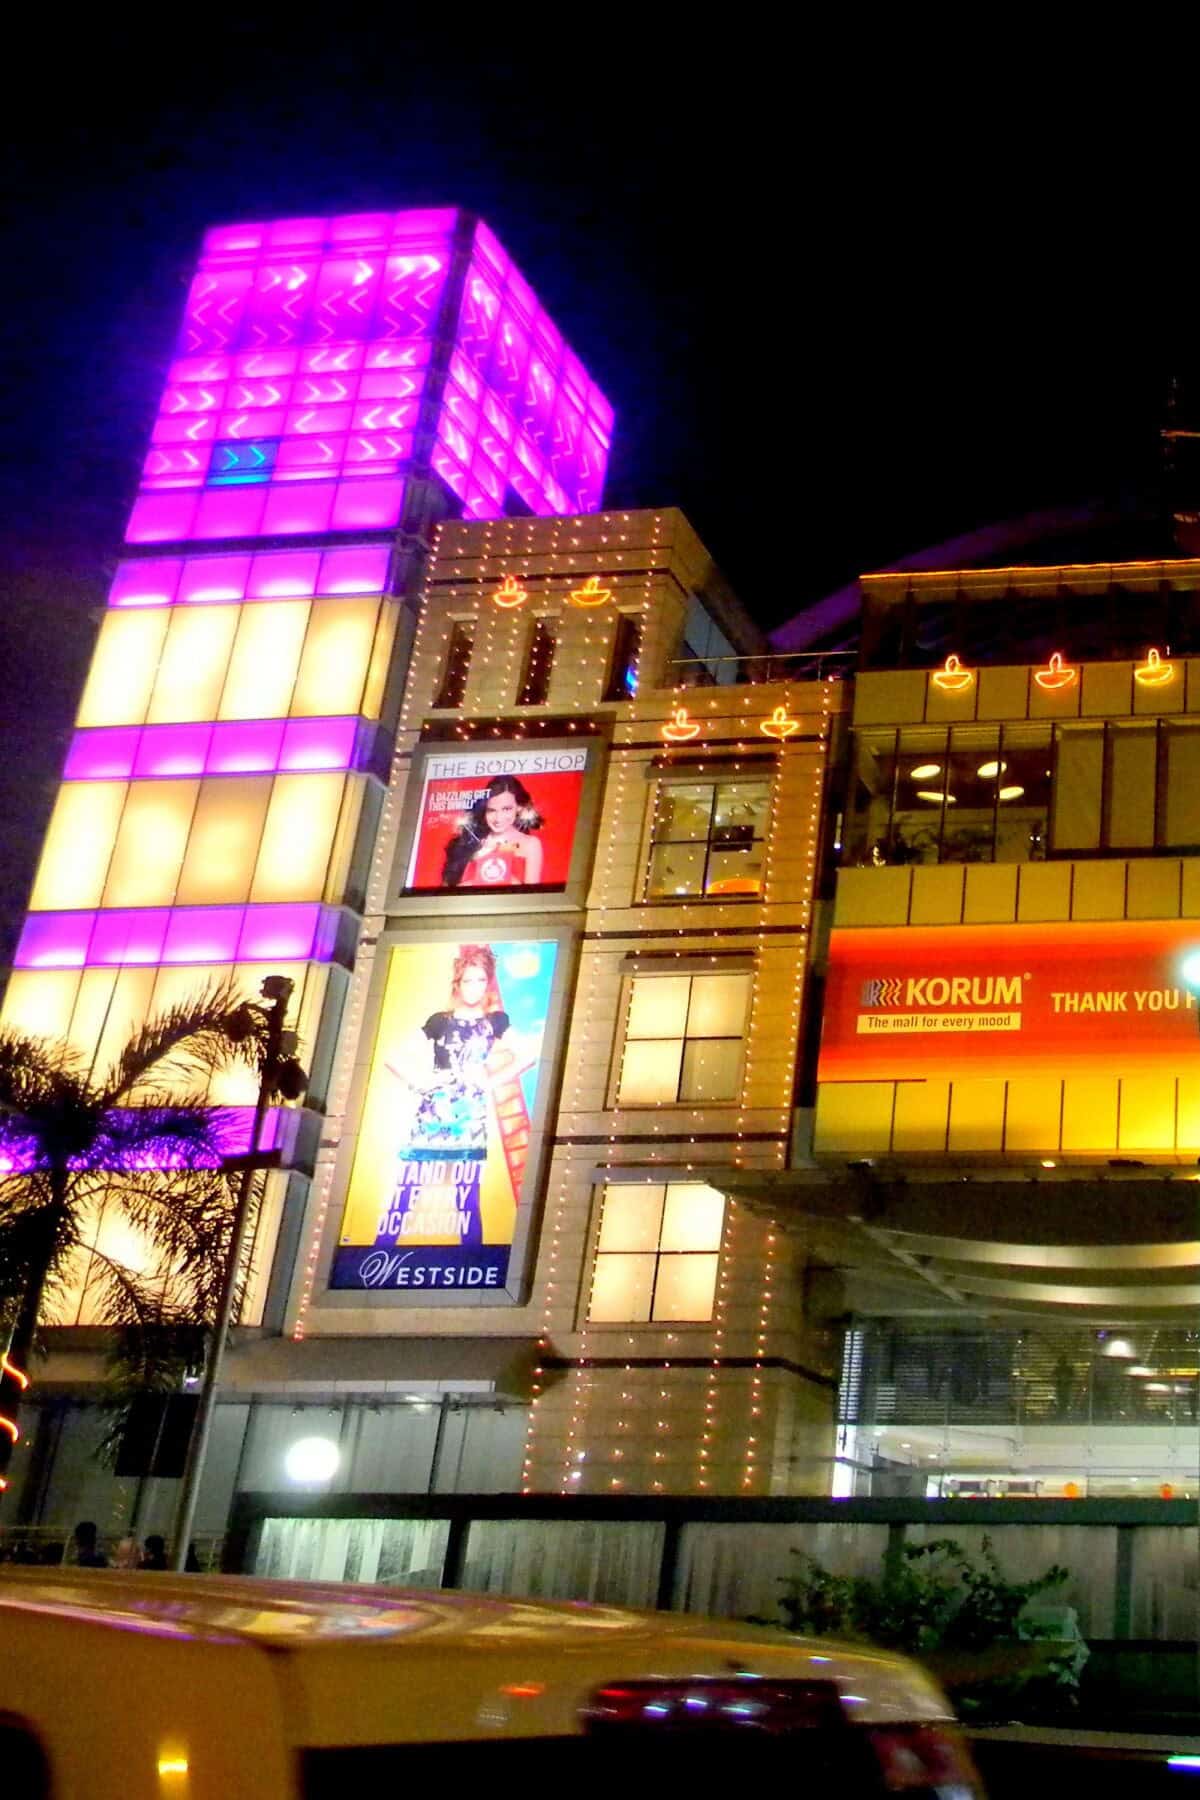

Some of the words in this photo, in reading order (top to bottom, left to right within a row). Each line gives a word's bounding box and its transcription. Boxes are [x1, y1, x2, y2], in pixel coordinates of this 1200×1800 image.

[431, 761, 466, 777] THE
[474, 758, 528, 775] BODY
[534, 754, 585, 771] SHOP
[906, 976, 1023, 1006] KORUM
[1050, 991, 1128, 1013] THANK
[1133, 989, 1180, 1011] YOU
[867, 1016, 889, 1028] The
[892, 1017, 918, 1028] mall
[922, 1016, 939, 1027] for
[942, 1017, 974, 1029] every
[978, 1015, 1011, 1027] mood
[389, 1160, 447, 1185] TAND
[359, 1250, 499, 1288] WESTSIDE
